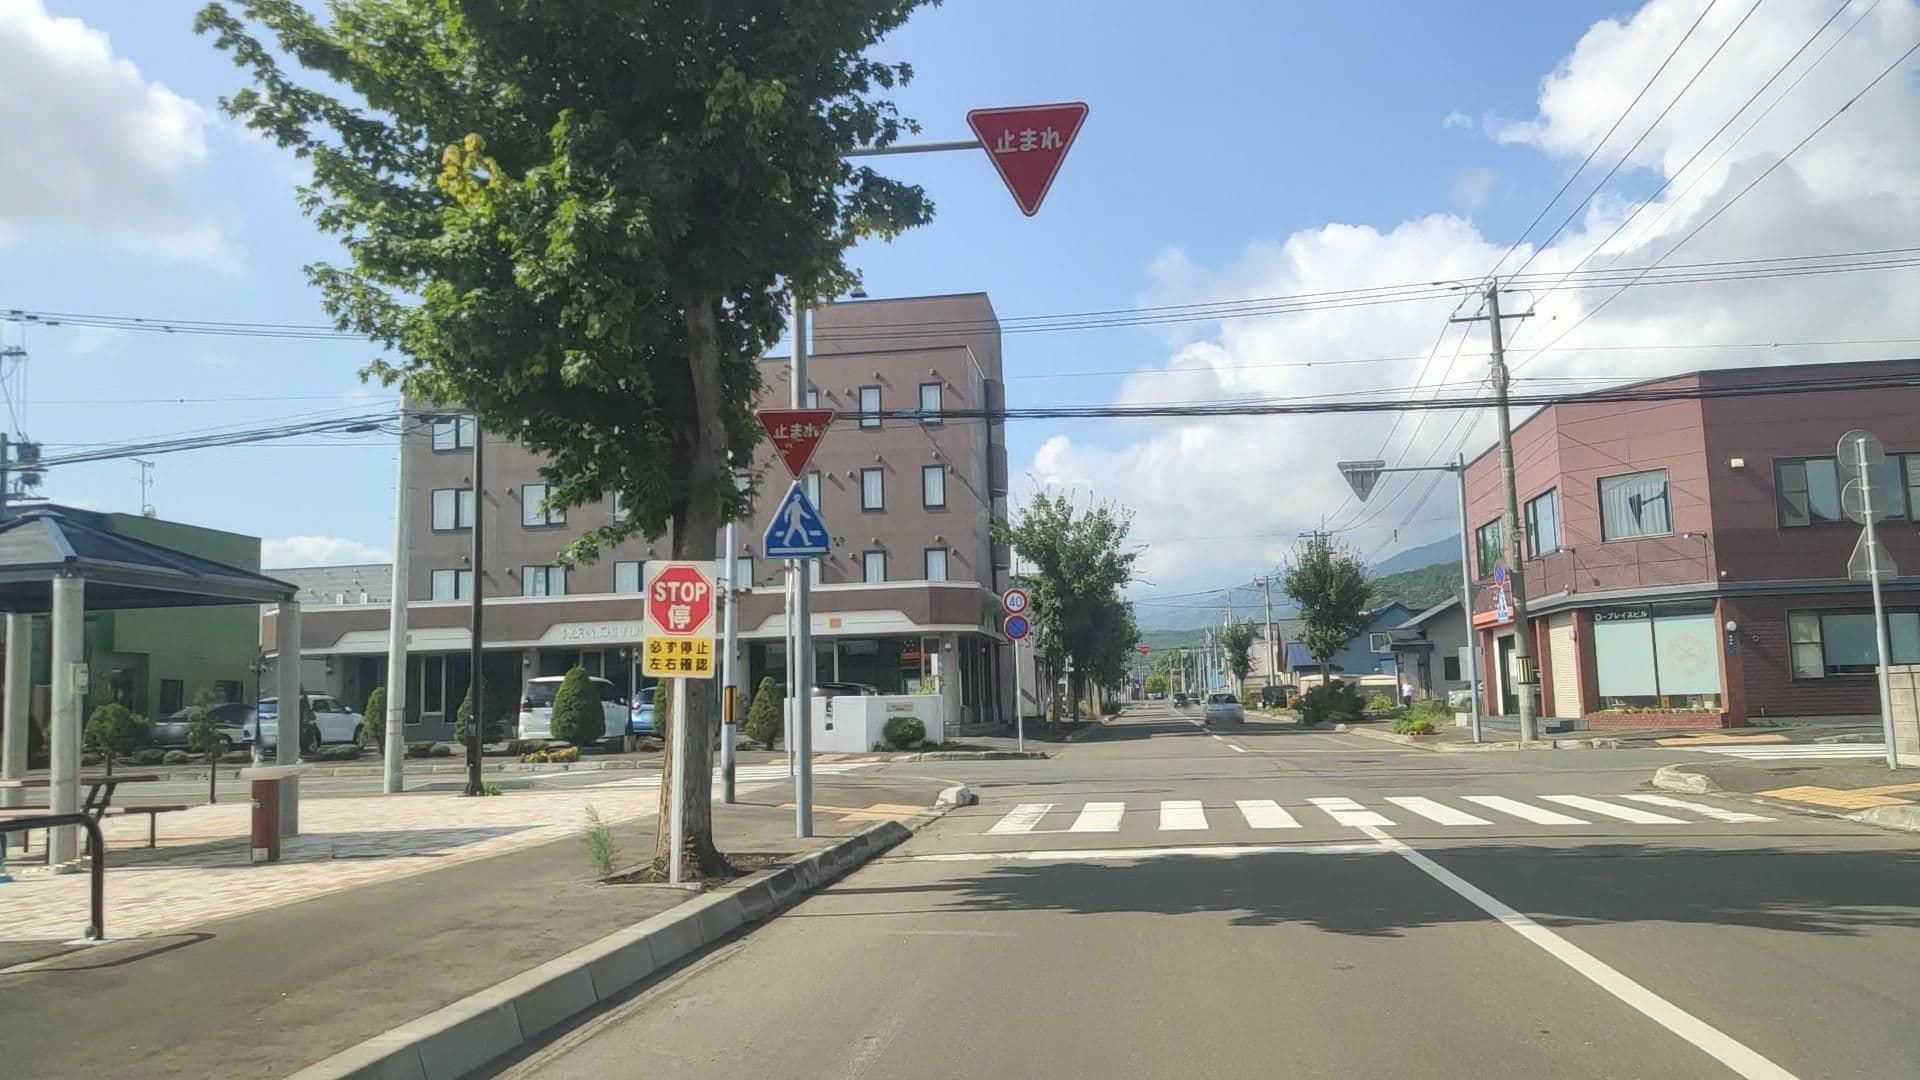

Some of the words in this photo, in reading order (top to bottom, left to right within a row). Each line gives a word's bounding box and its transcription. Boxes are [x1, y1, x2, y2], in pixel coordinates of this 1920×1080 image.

[994, 126, 1063, 153] 止まれ
[655, 581, 707, 602] STOP
[1009, 596, 1022, 607] 40
[668, 604, 691, 630] 停
[650, 641, 709, 655] 必ず停止
[650, 658, 708, 671] 左右確認
